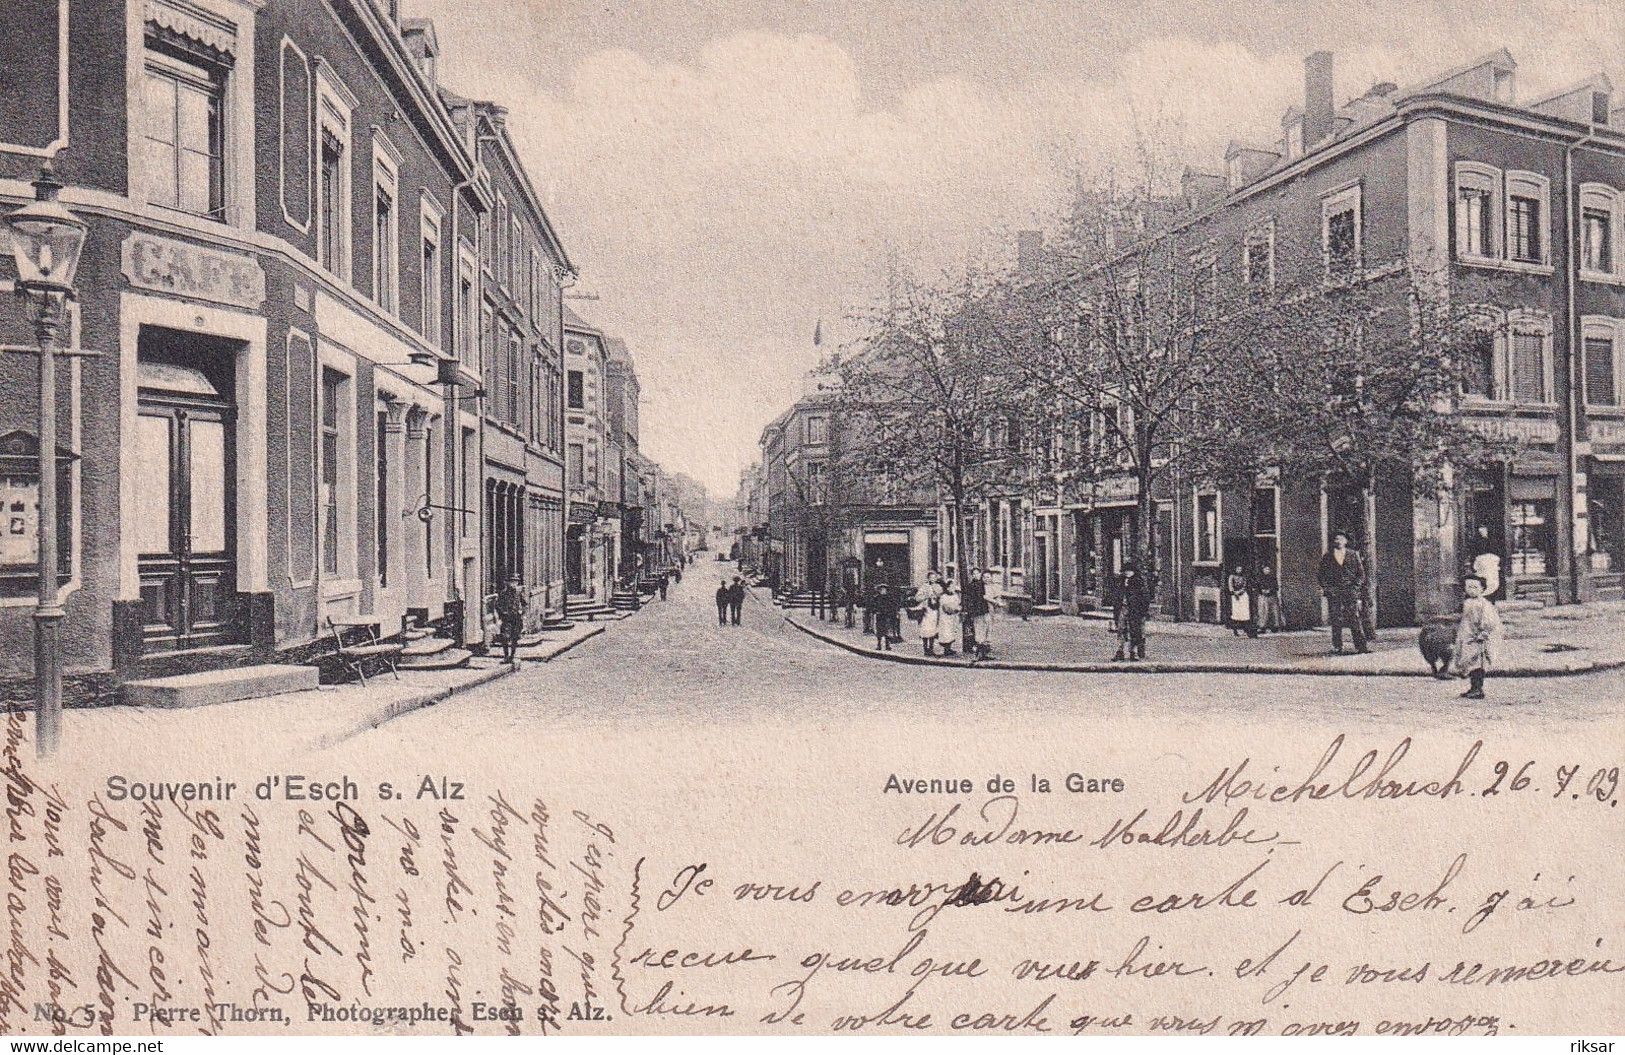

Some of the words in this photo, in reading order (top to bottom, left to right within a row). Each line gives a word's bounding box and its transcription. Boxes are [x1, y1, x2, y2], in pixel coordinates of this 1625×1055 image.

[107, 776, 236, 801] Souvenir
[256, 775, 359, 801] d'Esch
[378, 782, 402, 800] s.
[416, 776, 466, 801] Alz
[883, 774, 973, 794] Avenue
[986, 773, 1015, 794] de
[1031, 773, 1051, 794] la
[1066, 773, 1125, 794] Gare
[132, 1002, 200, 1023] Pierre
[215, 1002, 291, 1027] Thorn,
[471, 1002, 523, 1022] Esch
[566, 1001, 613, 1022] Alz.
